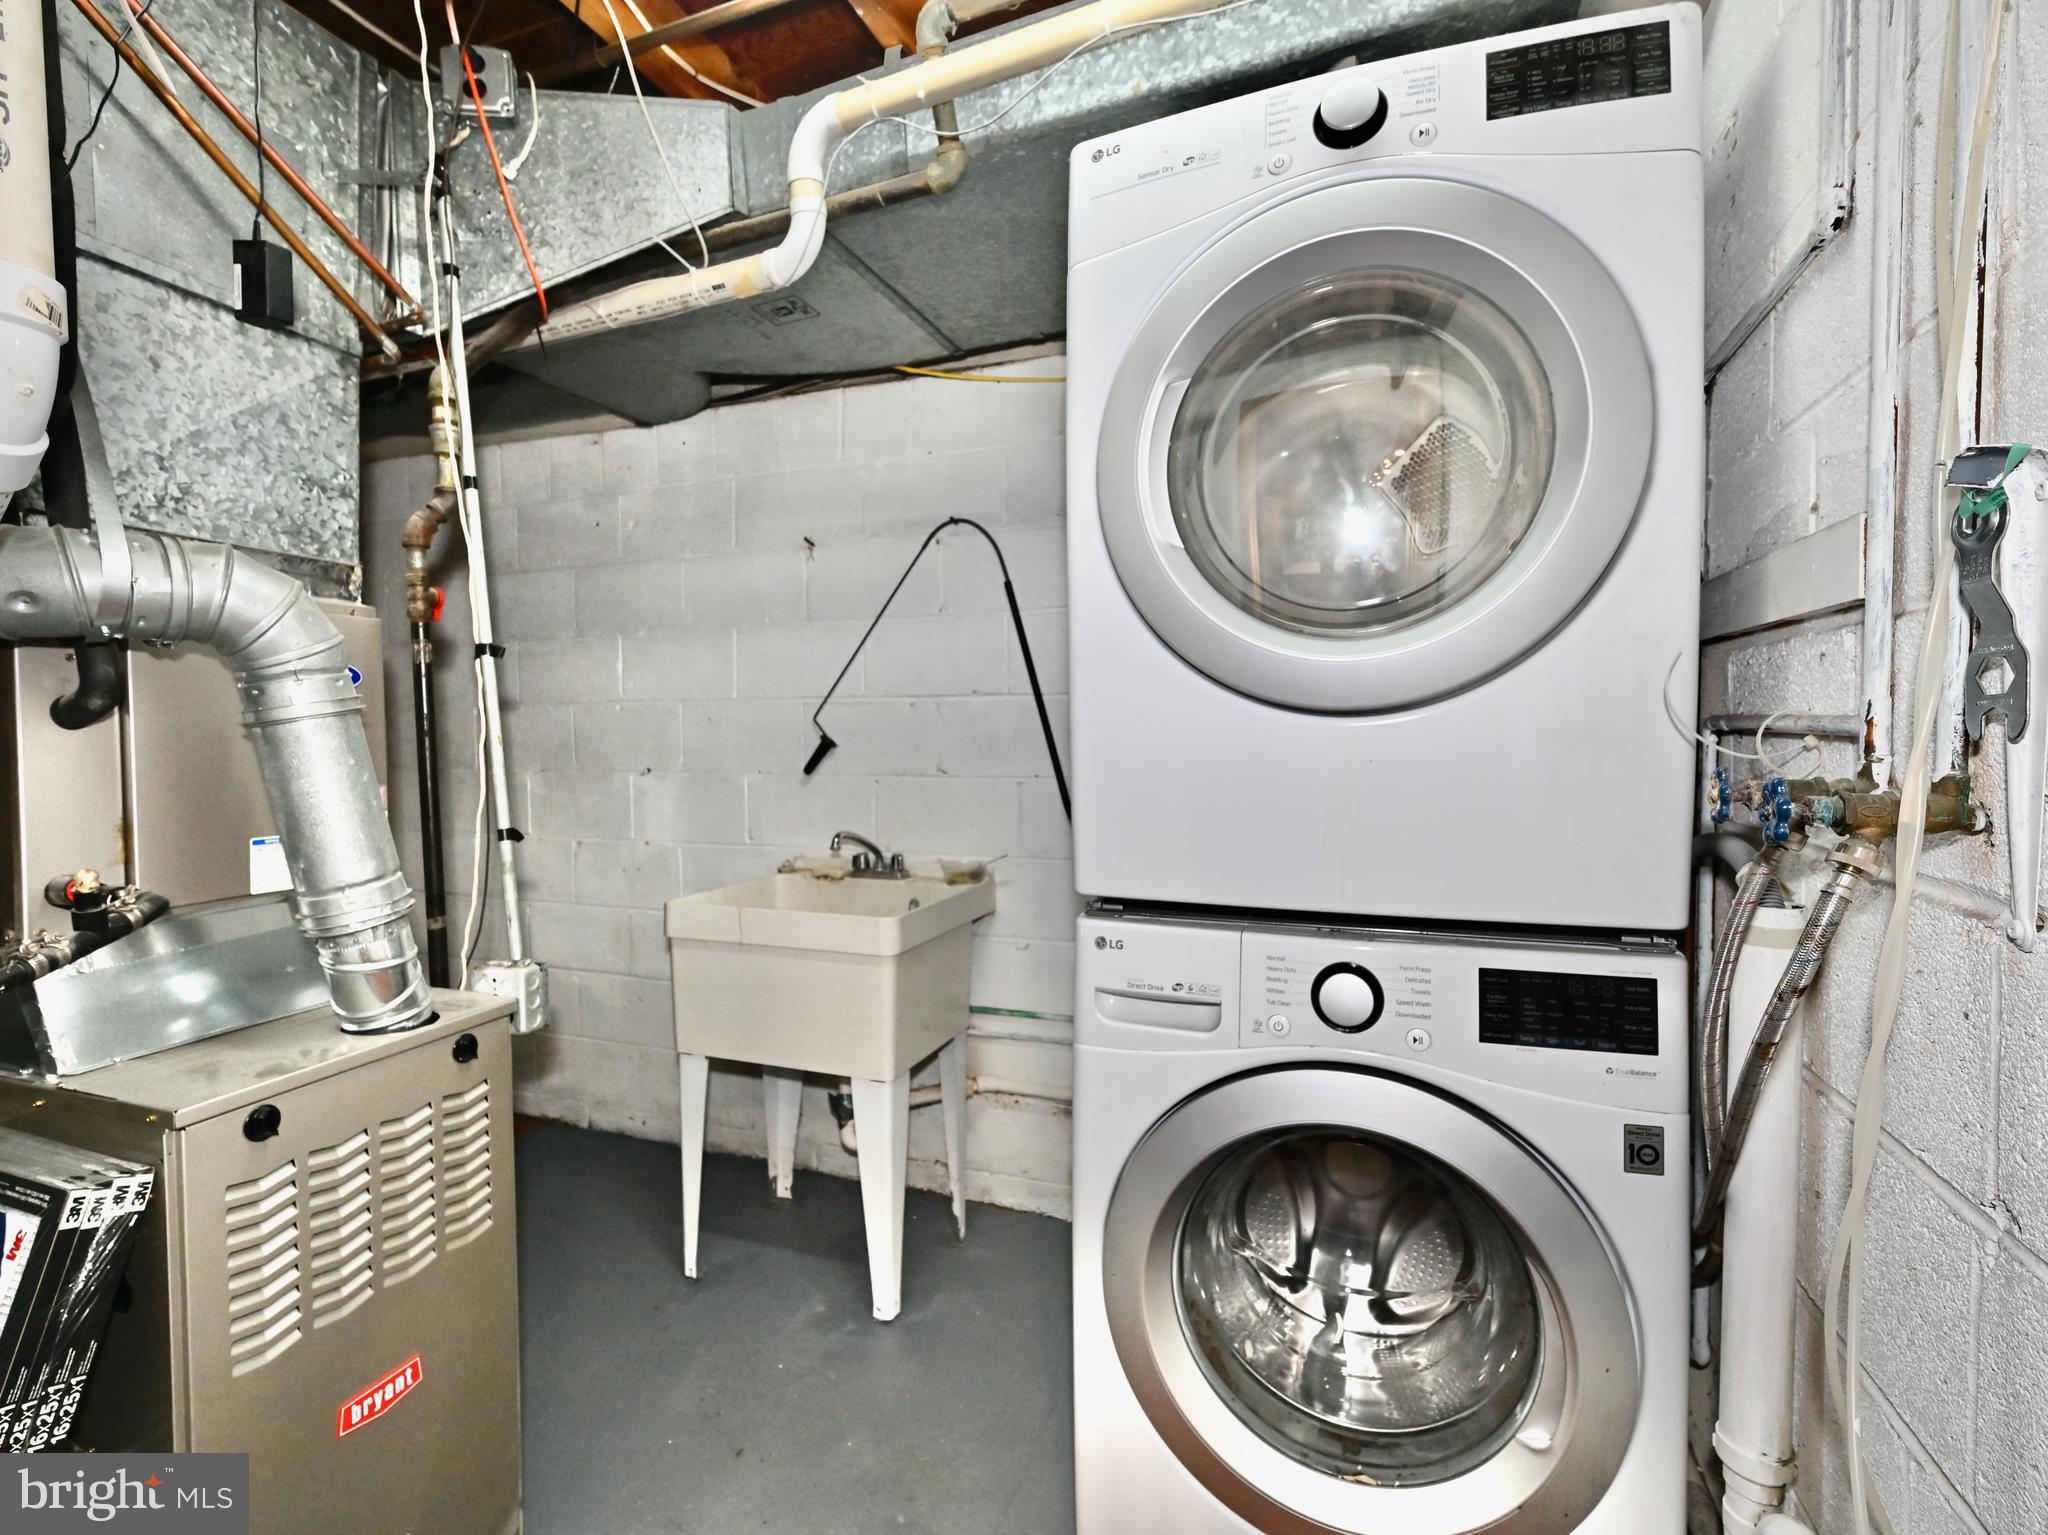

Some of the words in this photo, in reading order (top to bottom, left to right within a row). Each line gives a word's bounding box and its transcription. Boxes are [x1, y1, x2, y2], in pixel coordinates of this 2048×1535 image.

[1106, 144, 1121, 156] LG
[1137, 169, 1160, 180] Sensor
[1162, 166, 1174, 174] Dry
[1109, 939, 1124, 950] LG
[1127, 982, 1146, 990] Direct
[1147, 983, 1164, 992] Drive
[1396, 999, 1414, 1007] Speed
[1396, 1010, 1432, 1020] Downloaded
[1628, 1143, 1660, 1166] 10
[132, 1181, 152, 1206] 3M
[66, 1196, 86, 1224] 3M
[87, 1196, 107, 1223] 3M
[352, 1368, 412, 1424] bryant
[27, 1384, 66, 1453] 16x25x1
[51, 1375, 87, 1444] 16x25x1
